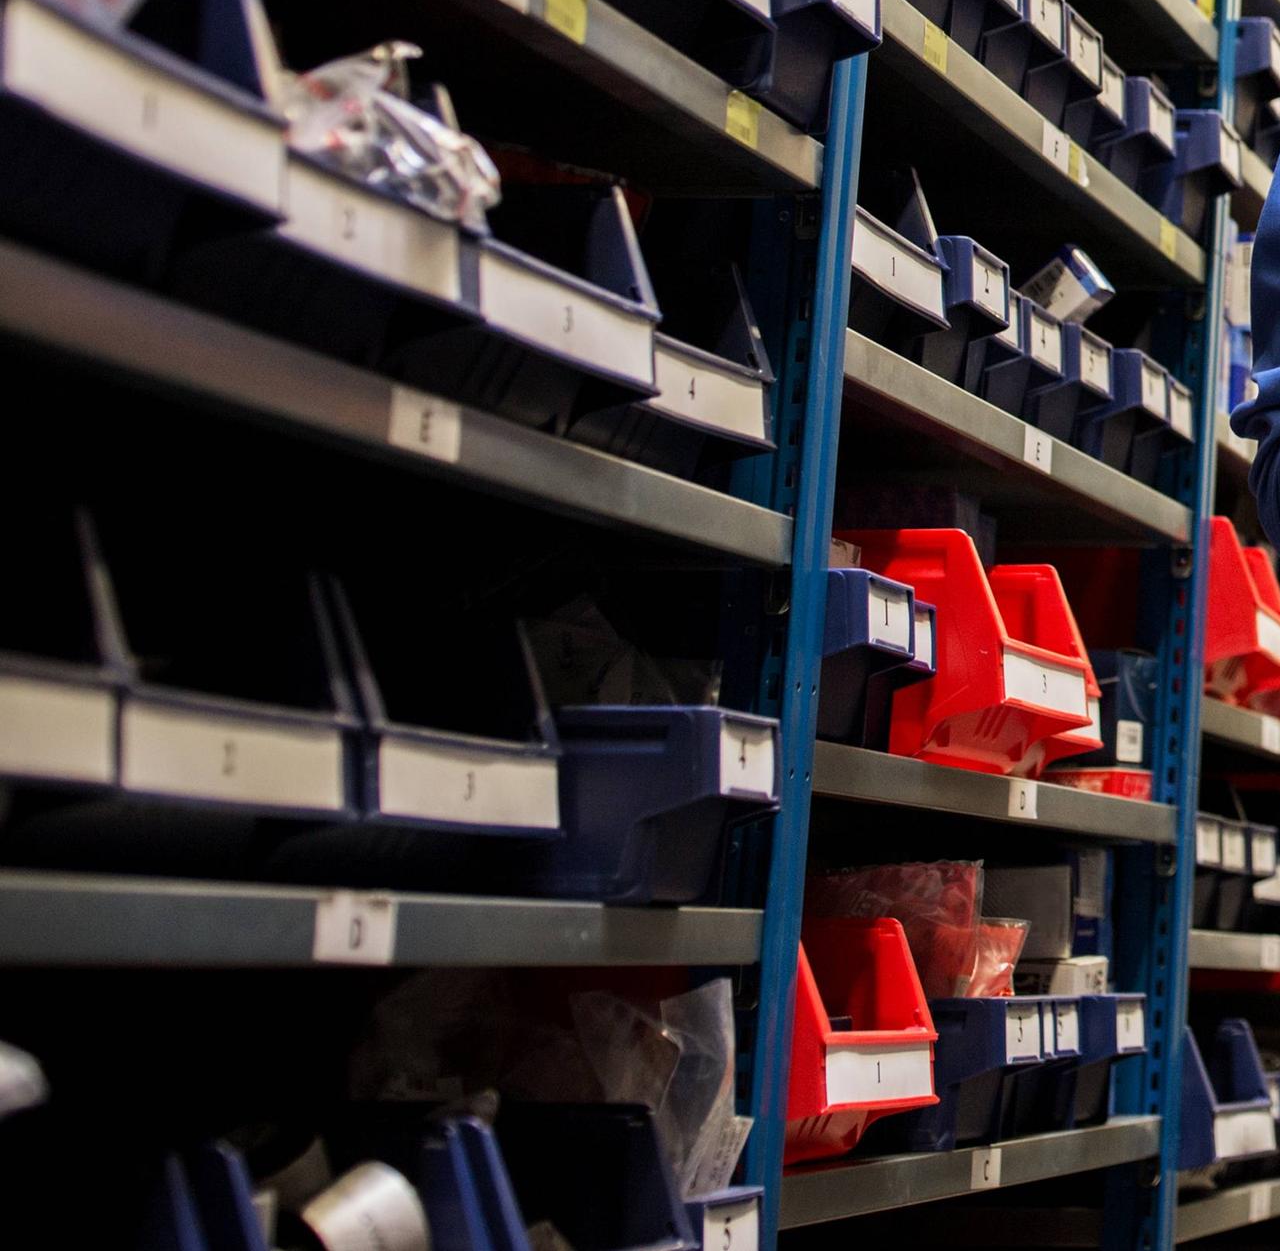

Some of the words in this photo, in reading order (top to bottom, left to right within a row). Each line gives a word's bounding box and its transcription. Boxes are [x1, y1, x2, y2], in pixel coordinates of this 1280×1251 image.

[891, 256, 896, 277] 1
[983, 267, 990, 294] 2
[688, 376, 695, 400] 4
[1035, 441, 1041, 461] E
[884, 597, 890, 626] 1
[1041, 673, 1048, 694] 3
[738, 737, 746, 770] 4
[876, 1060, 881, 1084] 1
[723, 1215, 732, 1251] 5
